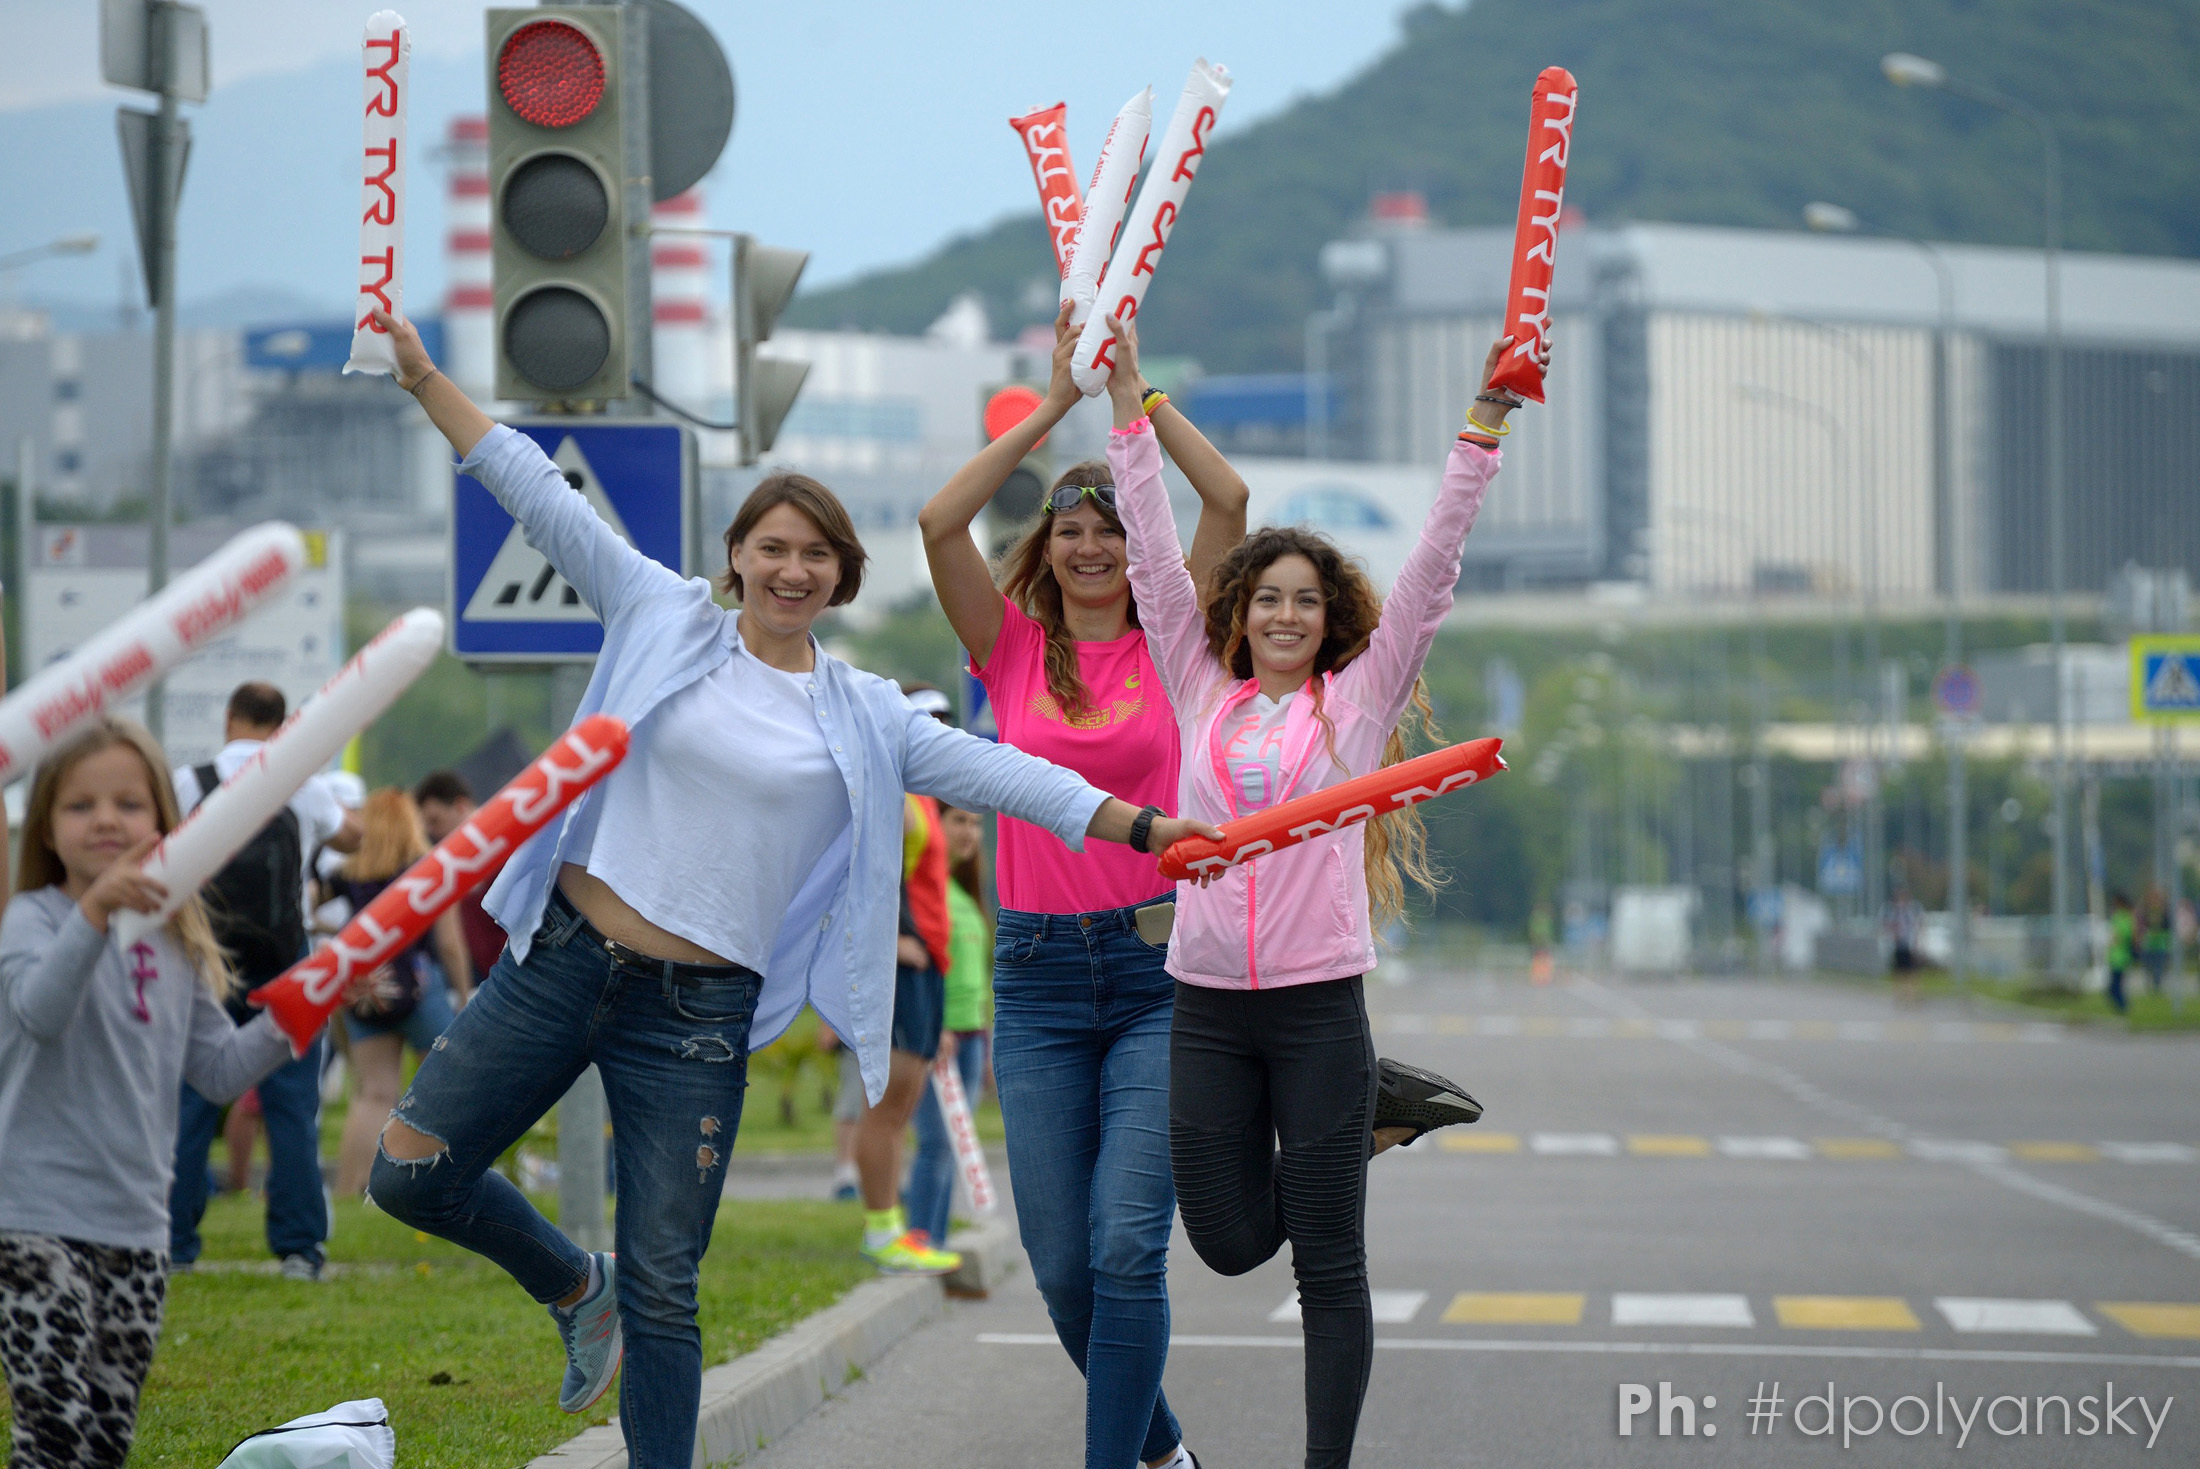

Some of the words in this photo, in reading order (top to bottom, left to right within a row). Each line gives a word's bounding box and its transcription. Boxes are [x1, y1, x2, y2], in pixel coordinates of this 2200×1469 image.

[366, 29, 400, 118] TYR
[1027, 121, 1069, 191] TYR
[1539, 90, 1577, 169] TYR
[363, 137, 396, 227] TYR
[1526, 186, 1563, 267] TYR
[358, 245, 394, 334] TYR
[1513, 283, 1550, 364] TYR
[499, 733, 615, 825] TYR
[396, 822, 510, 914] TYR
[290, 912, 405, 1005] TYR
